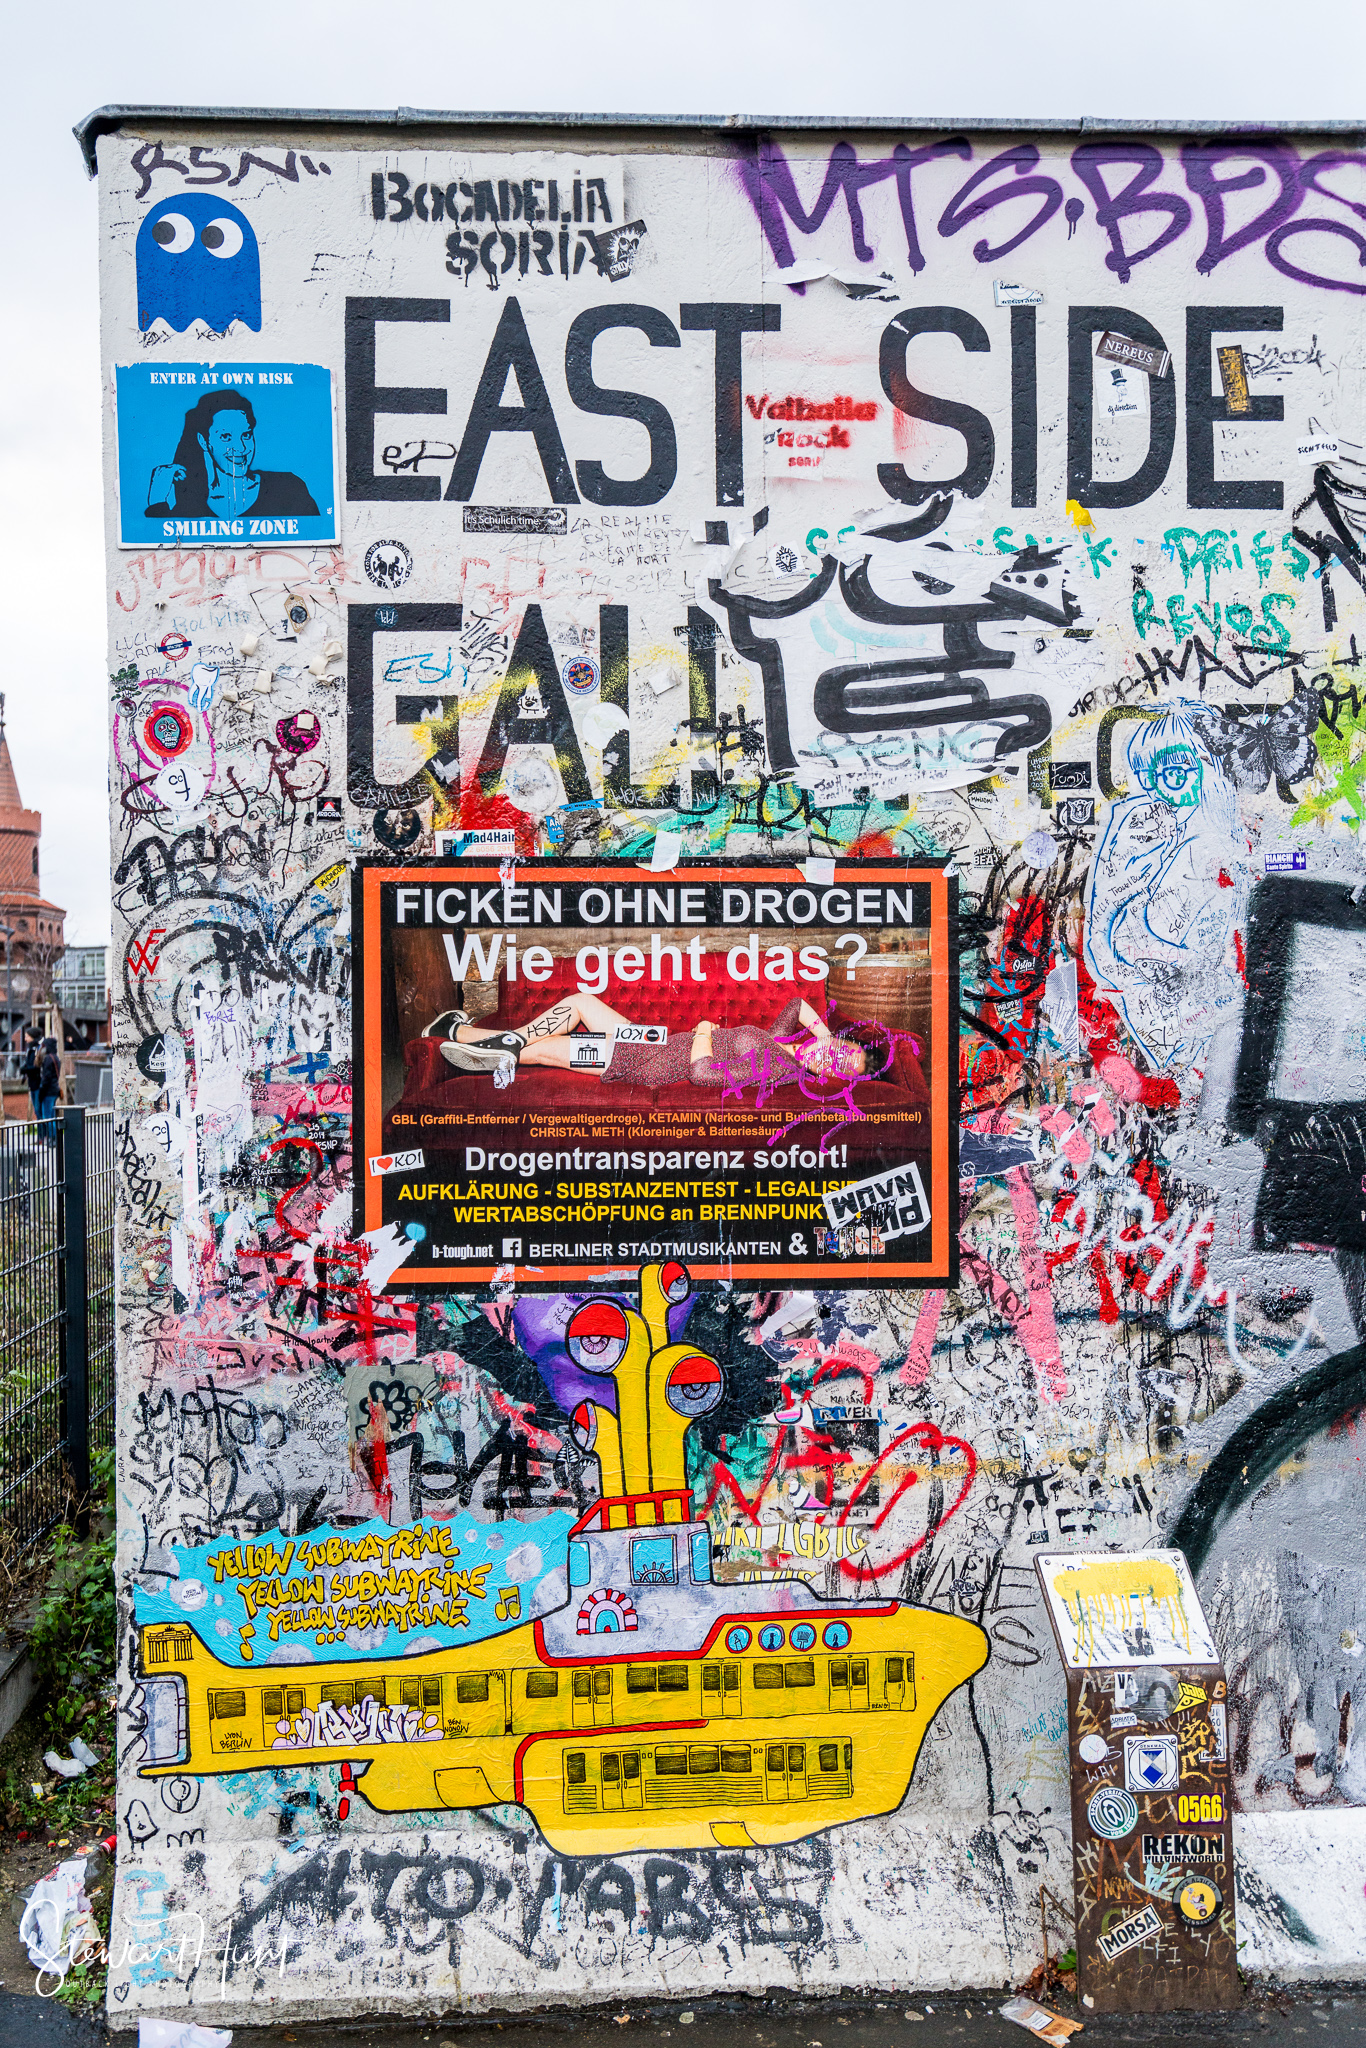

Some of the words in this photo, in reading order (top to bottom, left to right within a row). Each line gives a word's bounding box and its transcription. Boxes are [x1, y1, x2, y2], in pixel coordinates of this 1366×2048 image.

[1104, 338, 1154, 363] NEREUS
[150, 372, 197, 384] ENTER
[201, 372, 219, 384] AT
[222, 372, 254, 384] OWN
[258, 372, 294, 385] RISK
[345, 296, 781, 507] EAST
[877, 304, 1285, 510] SIDE
[163, 520, 244, 537] SMILING
[250, 519, 299, 535] ZONE
[464, 515, 477, 525] It's
[478, 515, 518, 526] Schulich
[518, 516, 542, 526] time.
[1265, 854, 1293, 863] BIANCHI
[396, 888, 562, 923] FICKEN
[578, 888, 706, 923] OHNE
[722, 888, 913, 924] DROGEN
[442, 933, 554, 982] Wie
[575, 933, 707, 995] geht
[726, 933, 869, 982] das?
[391, 1114, 418, 1125] GBL
[420, 1114, 520, 1127] (Graffiti-Entferner
[528, 1112, 646, 1126] Vergewaltigerdroge),
[648, 1112, 702, 1123] KETAMIN
[705, 1112, 759, 1124] (Narkose-
[761, 1112, 782, 1123] und
[530, 1128, 589, 1138] CHRISTAL
[592, 1127, 625, 1137] METH
[628, 1127, 697, 1139] (Kloreiniger
[698, 1127, 707, 1137] &
[394, 1151, 422, 1169] KOI
[465, 1147, 745, 1177] Drogentransparenz
[753, 1144, 848, 1169] sofort!
[398, 1179, 539, 1201] AUFKLÄRUNG
[556, 1181, 739, 1200] SUBSTANZENTEST
[453, 1202, 665, 1223] WERTABSCHÖPFUNG
[670, 1206, 693, 1221] an
[432, 1243, 494, 1260] b-tough.net
[529, 1243, 614, 1258] BERLINER
[617, 1241, 782, 1257] STADTMUSIKANTEN
[788, 1232, 809, 1256] &
[207, 1540, 296, 1584] YELLOW
[237, 1575, 325, 1619] YELLOW
[266, 1605, 337, 1642] YELLOW
[444, 1722, 470, 1734] NONOW
[447, 1716, 462, 1725] BEN
[1178, 1795, 1223, 1823] 0566
[1144, 1834, 1224, 1856] REKON
[1103, 1912, 1158, 1953] MORSA
